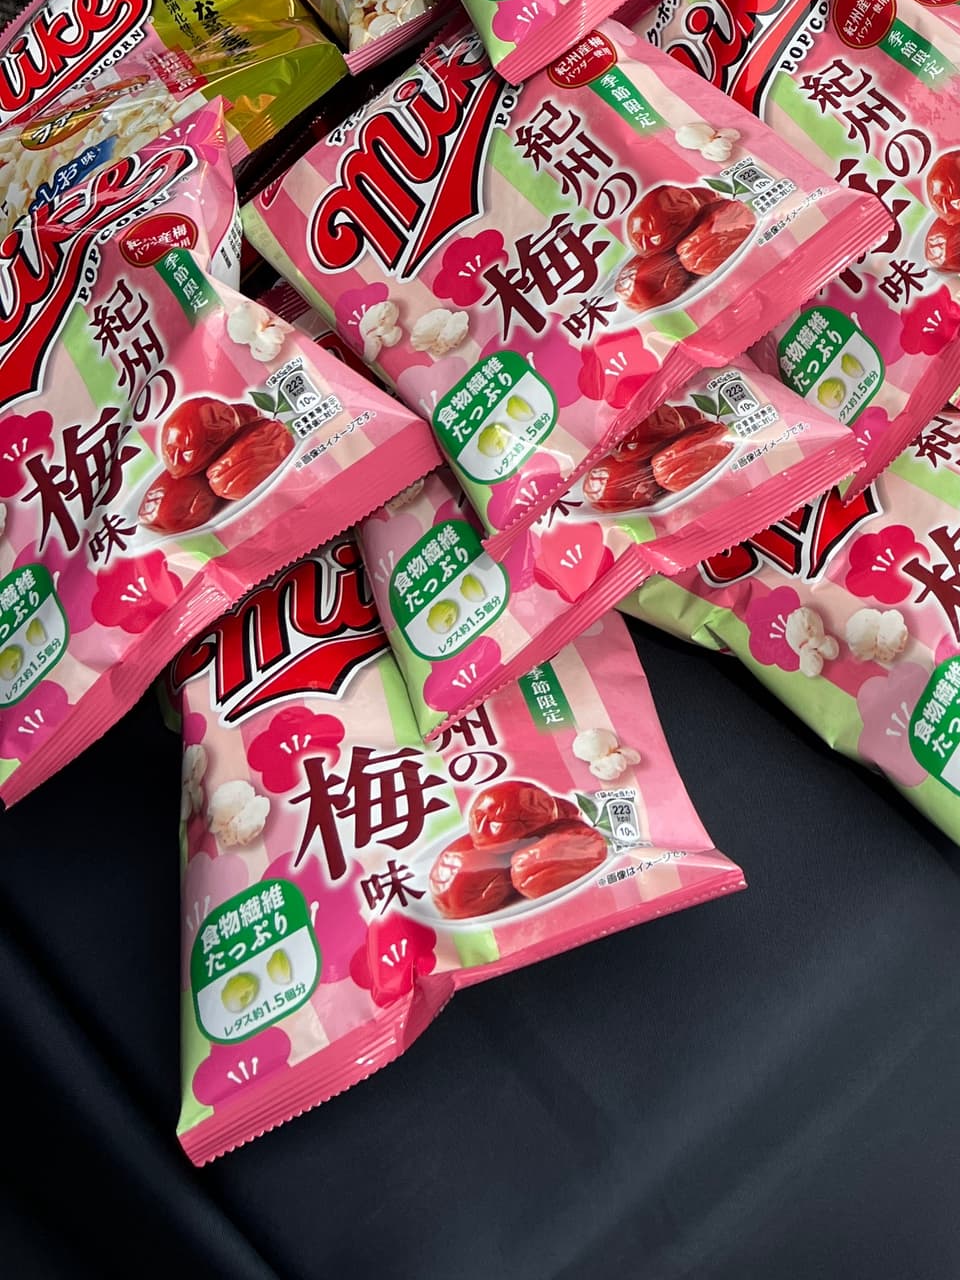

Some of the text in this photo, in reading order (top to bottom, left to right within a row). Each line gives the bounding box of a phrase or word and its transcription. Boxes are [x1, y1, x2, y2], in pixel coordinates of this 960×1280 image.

[554, 35, 606, 77] 紀州産梅
[887, 28, 945, 80] 季節限定
[599, 72, 657, 131] 季節限定
[799, 59, 932, 178] 紀州の
[511, 100, 639, 221] 紀州の
[739, 167, 758, 182] 223
[0, 146, 199, 405] ike
[163, 251, 210, 315] 季節限定
[91, 277, 177, 423] 紀州の
[779, 310, 830, 378] 食物繊維
[792, 329, 843, 393] たっぷり
[285, 375, 305, 394] 223
[298, 396, 317, 408] 10%
[436, 354, 505, 431] 食物繊維
[451, 367, 516, 442] たっぷり
[724, 384, 744, 399] 223
[739, 401, 756, 413] 10%
[393, 523, 461, 597] 食物繊維
[404, 546, 470, 614] たっぷり
[437, 595, 502, 654] レタス約1.5個分
[4, 637, 63, 701] レタス約1.5個分
[612, 804, 631, 816] 223
[619, 827, 635, 837] 10%
[200, 882, 285, 954] 食物繊維
[205, 911, 288, 978] たっぷり
[223, 982, 307, 1038] レタス約1.5個分
